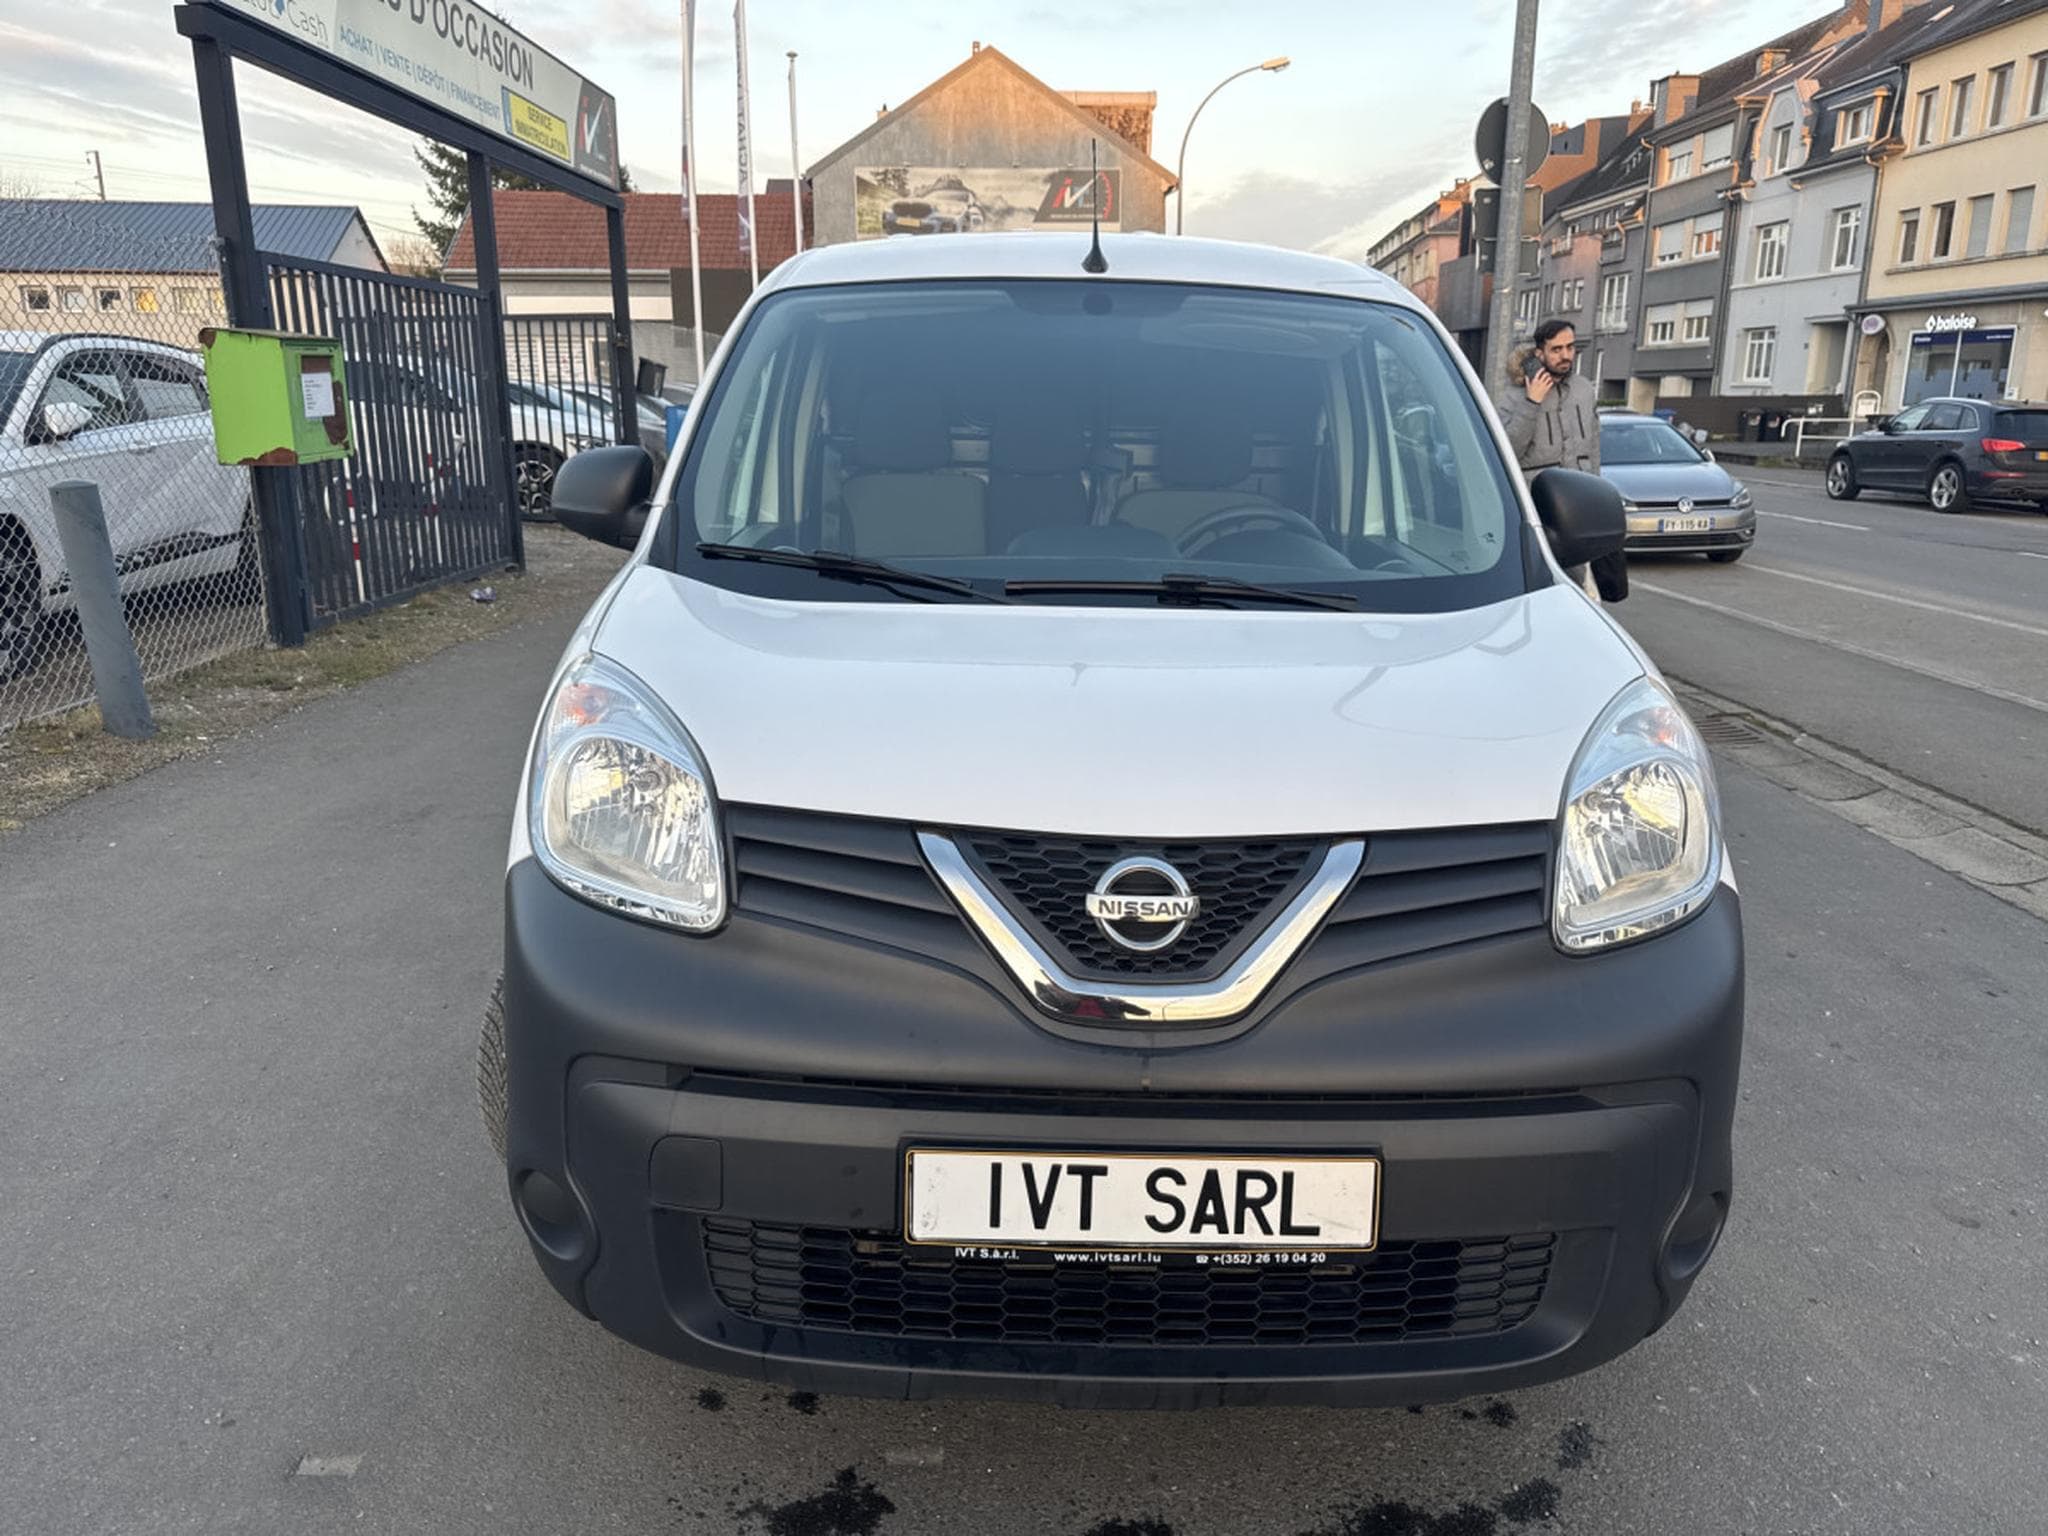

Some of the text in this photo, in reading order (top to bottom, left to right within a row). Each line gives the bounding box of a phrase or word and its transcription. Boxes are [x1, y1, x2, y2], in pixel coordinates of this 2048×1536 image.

[286, 0, 329, 41] Cash
[340, 25, 374, 57] ACHAT
[380, 45, 412, 77] VENTE
[416, 63, 445, 92] DÉPÔT
[410, 0, 534, 90] DOCCASION
[1936, 312, 1977, 330] baloise
[1098, 900, 1189, 917] NISSAN
[989, 1161, 1321, 1237] IVT SARL
[954, 1247, 977, 1258] IVT
[1212, 1253, 1327, 1265] +(352) 26 19 04 20
